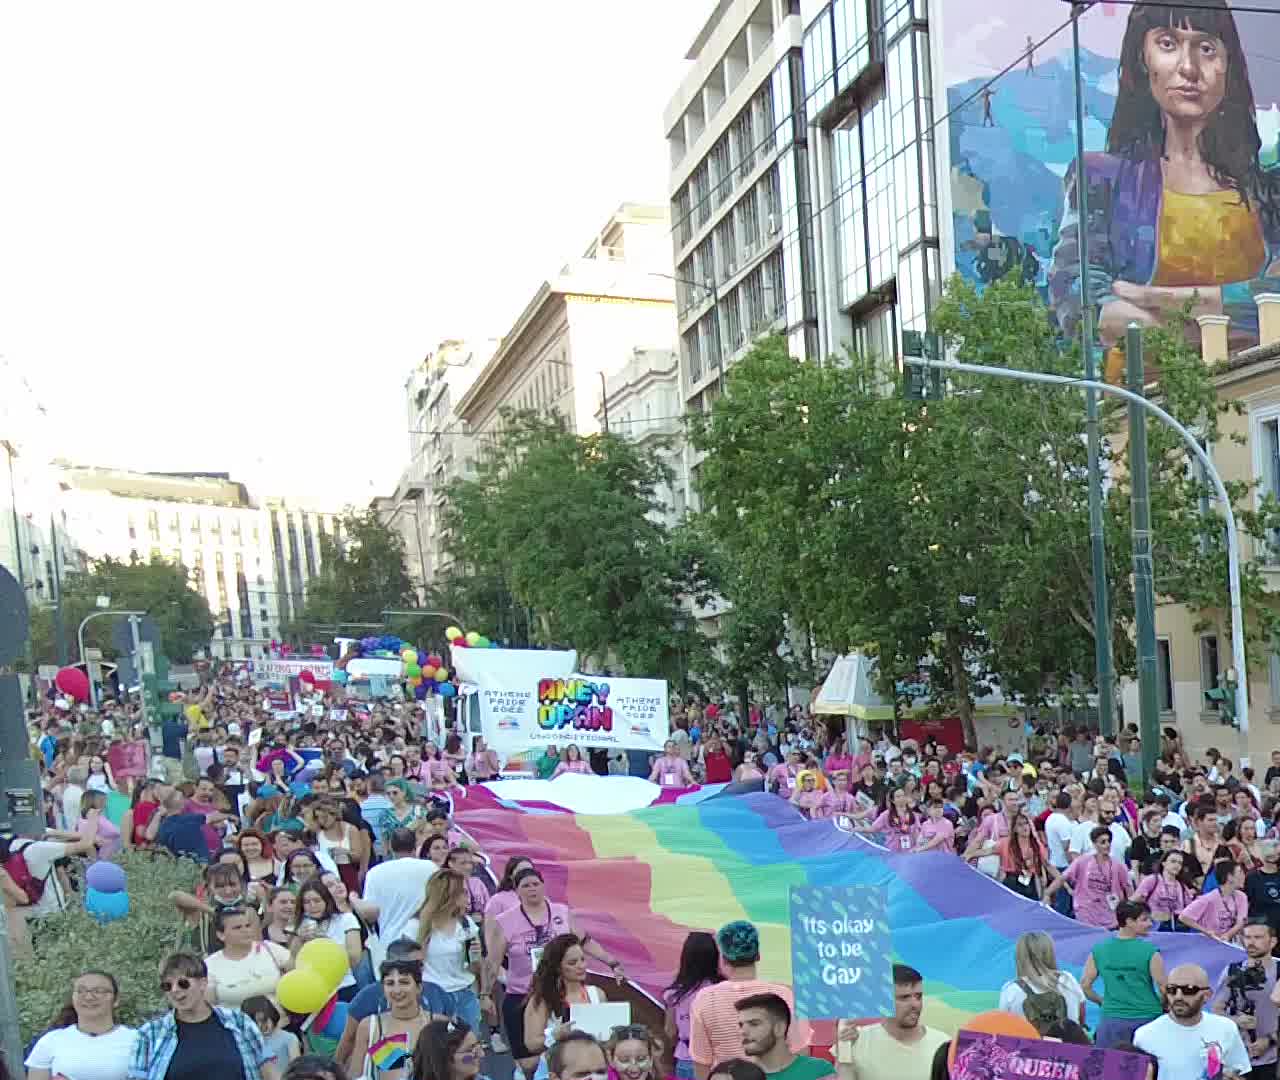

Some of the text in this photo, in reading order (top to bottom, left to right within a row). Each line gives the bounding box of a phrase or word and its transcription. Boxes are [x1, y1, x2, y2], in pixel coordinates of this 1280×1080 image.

[832, 913, 874, 935] okay
[817, 940, 862, 957] to be
[822, 963, 862, 985] Gay
